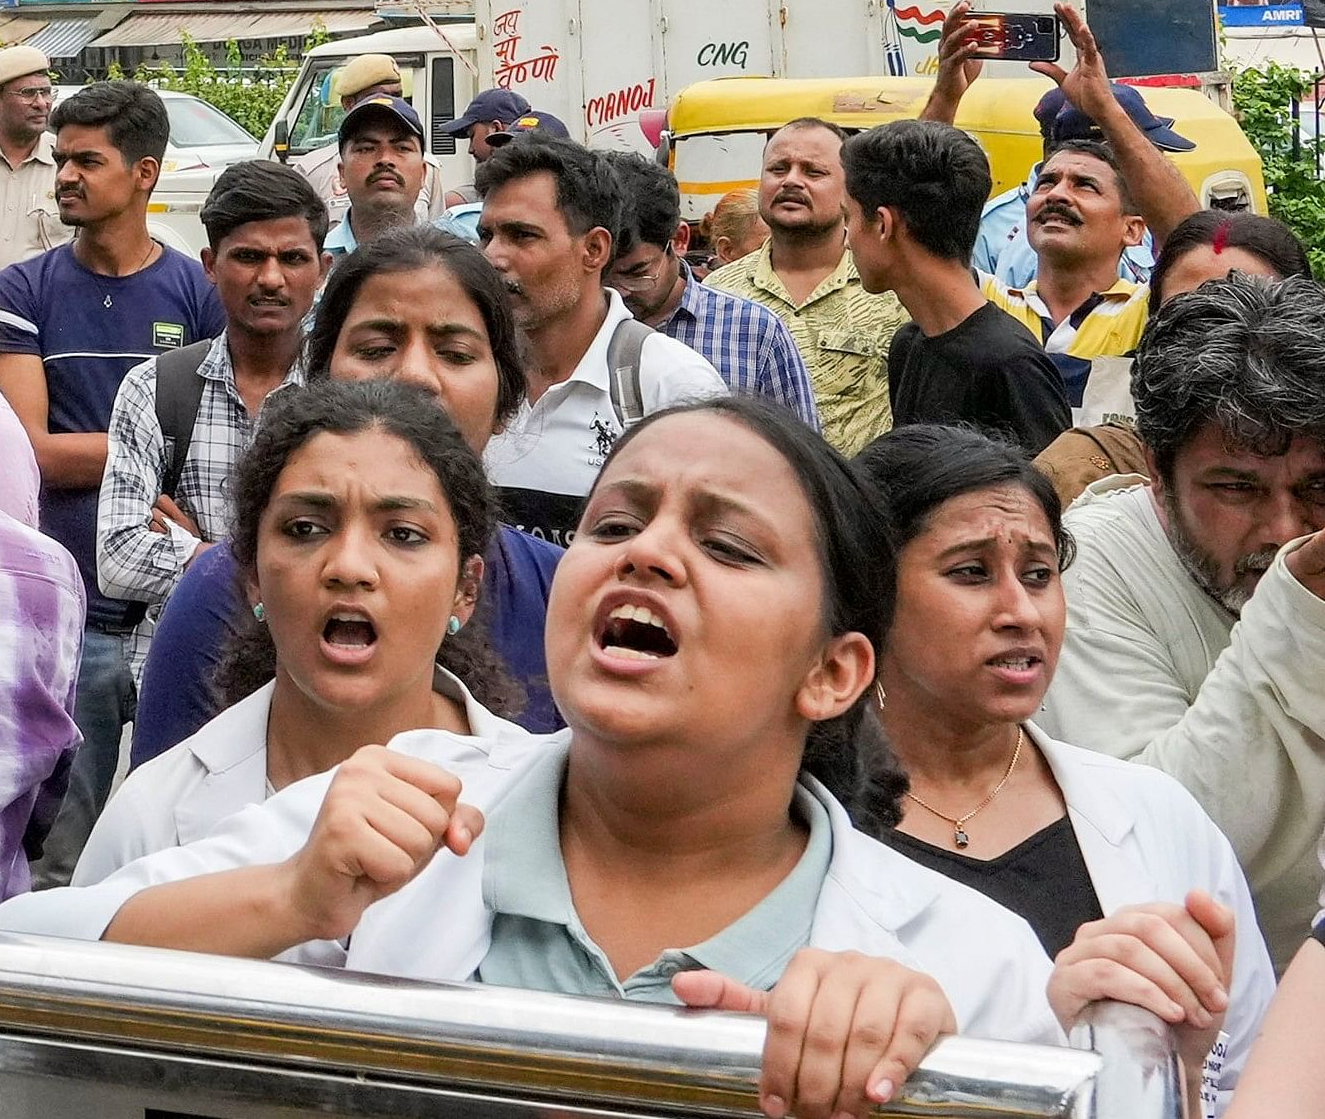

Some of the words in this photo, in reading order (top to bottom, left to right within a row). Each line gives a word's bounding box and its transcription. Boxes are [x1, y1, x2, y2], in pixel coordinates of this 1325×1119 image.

[493, 10, 522, 36] जय
[697, 41, 750, 69] CNG
[586, 78, 655, 127] MANOJ
